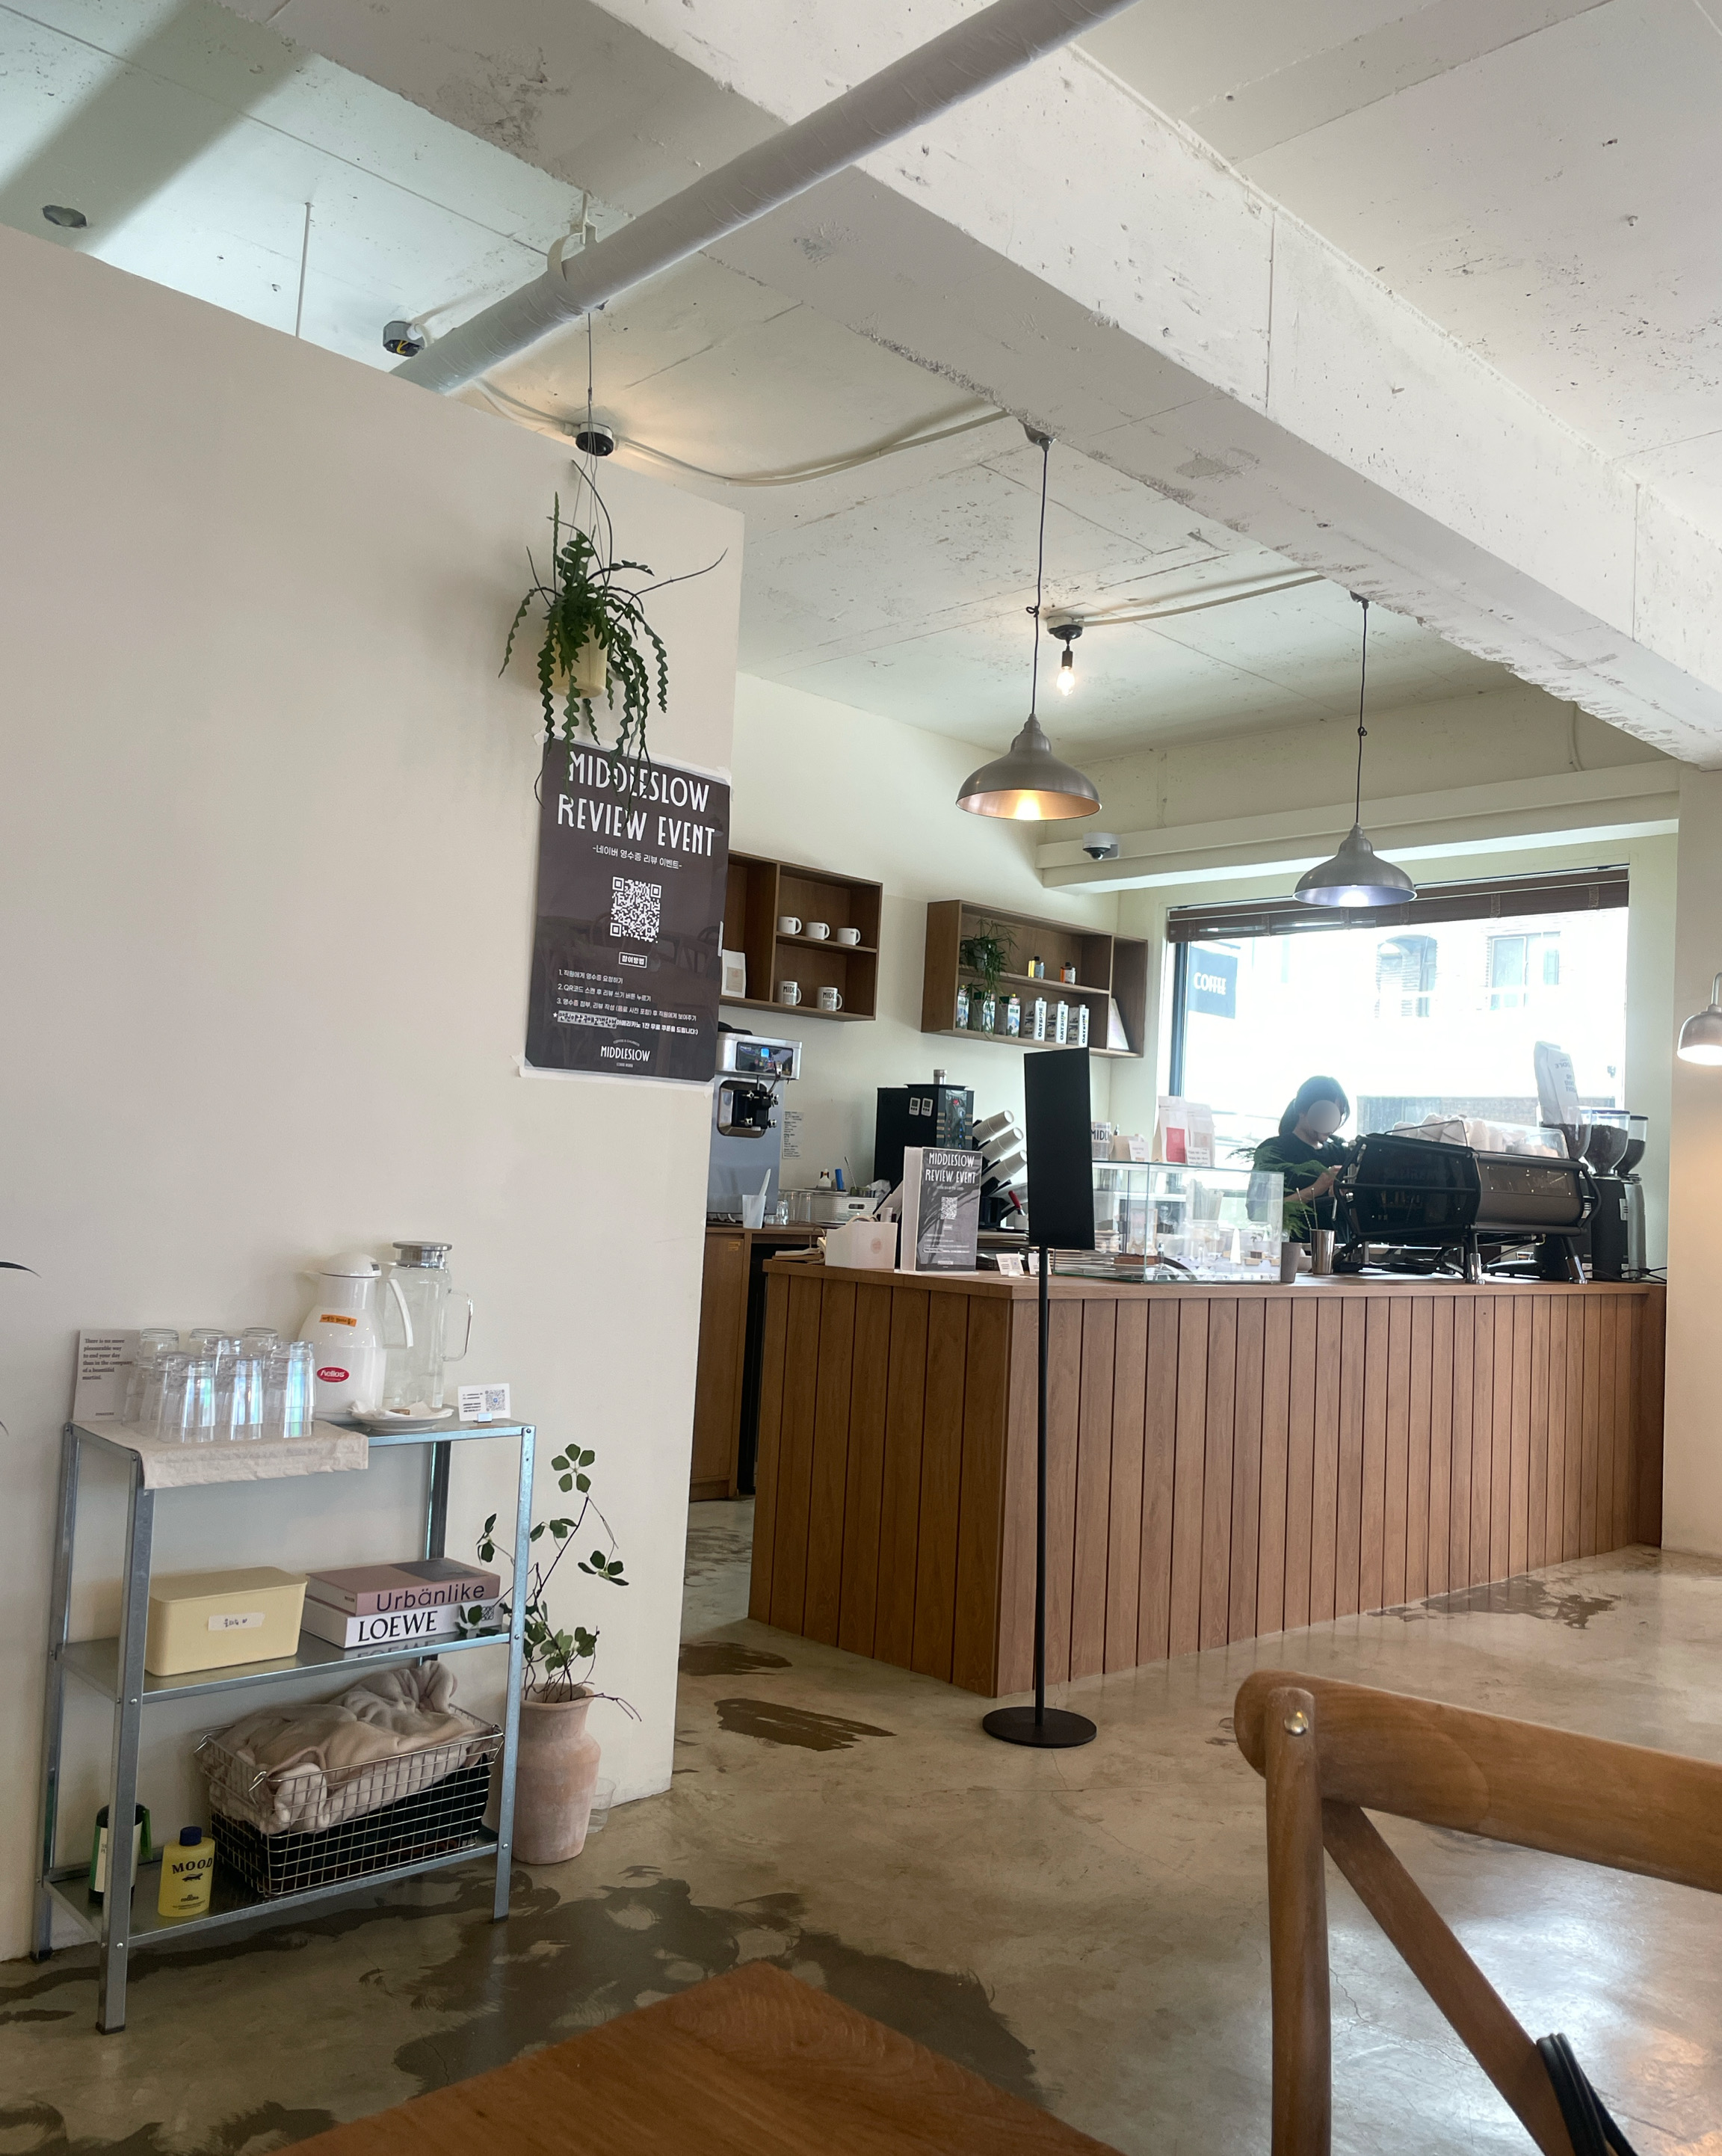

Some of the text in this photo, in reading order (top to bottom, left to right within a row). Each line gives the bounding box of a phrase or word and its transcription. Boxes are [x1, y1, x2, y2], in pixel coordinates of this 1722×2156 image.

[569, 751, 709, 813] MIDDLESLOW
[558, 793, 715, 857] REVIEW EVENT
[620, 849, 641, 862] 영수증
[644, 854, 658, 865] 리뷰
[1193, 972, 1226, 995] COFFEE
[600, 1046, 650, 1062] MIDDLESLOW
[929, 1152, 975, 1167] MIDDLESLOW
[925, 1168, 975, 1183] REVIEW EVENT
[376, 1583, 485, 1612] Urbänlike
[357, 1610, 438, 1642] LOEWE
[172, 1857, 213, 1875] MOOD
